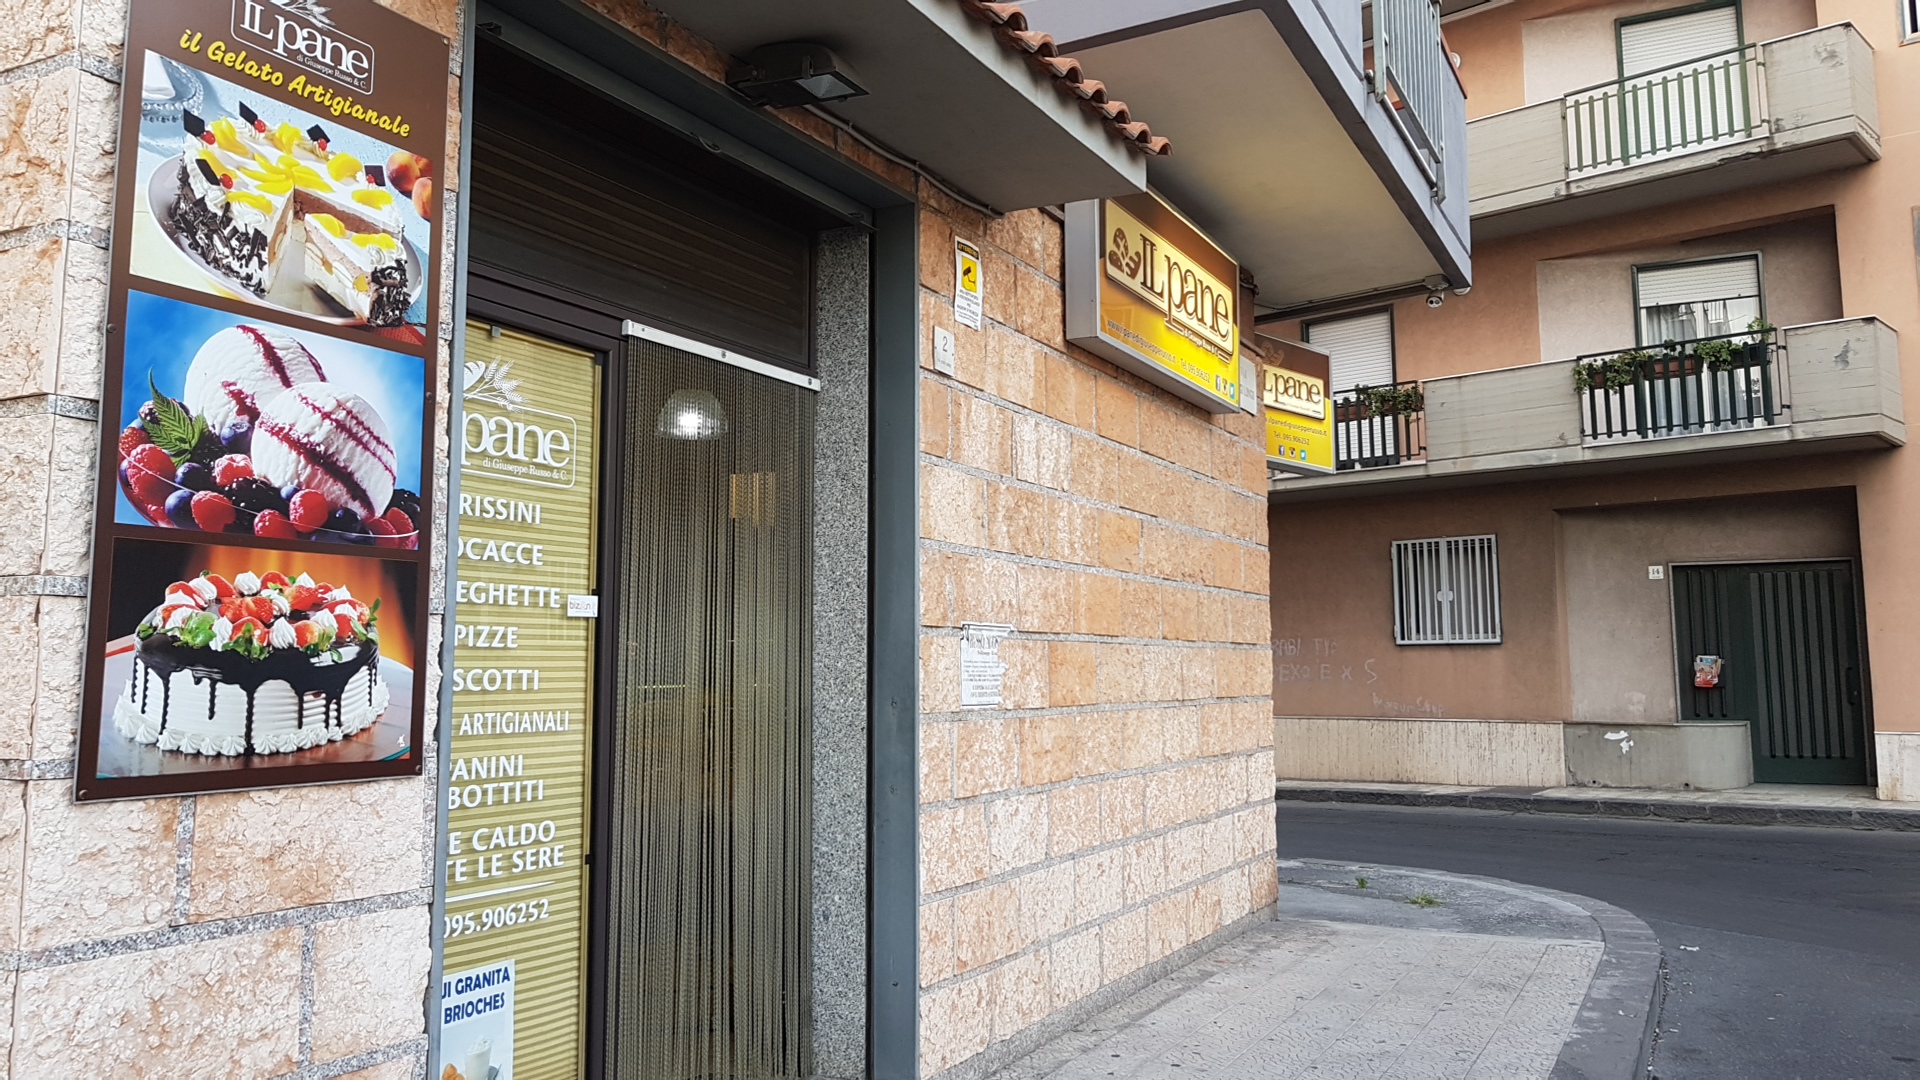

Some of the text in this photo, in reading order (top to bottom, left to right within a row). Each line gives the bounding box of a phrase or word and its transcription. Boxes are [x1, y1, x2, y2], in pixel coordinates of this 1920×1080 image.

[179, 29, 411, 137] il Gelato Artigianale
[304, 57, 334, 76] Giuseppe
[334, 69, 353, 84] Russo
[353, 78, 360, 87] &
[942, 335, 948, 353] 2
[483, 457, 568, 480] di Giuseppe Russo & C.
[454, 624, 519, 648] PIZZE
[452, 668, 540, 691] SCOTTI
[459, 710, 569, 736] ARTIGIANALI
[449, 754, 524, 781] ANINI
[448, 779, 544, 810] BOTTITI
[449, 820, 556, 855] E CALDO
[478, 853, 503, 878] LE
[512, 844, 565, 873] SERE
[455, 966, 511, 996] GRANITA
[444, 991, 506, 1025] BRIOCHES
